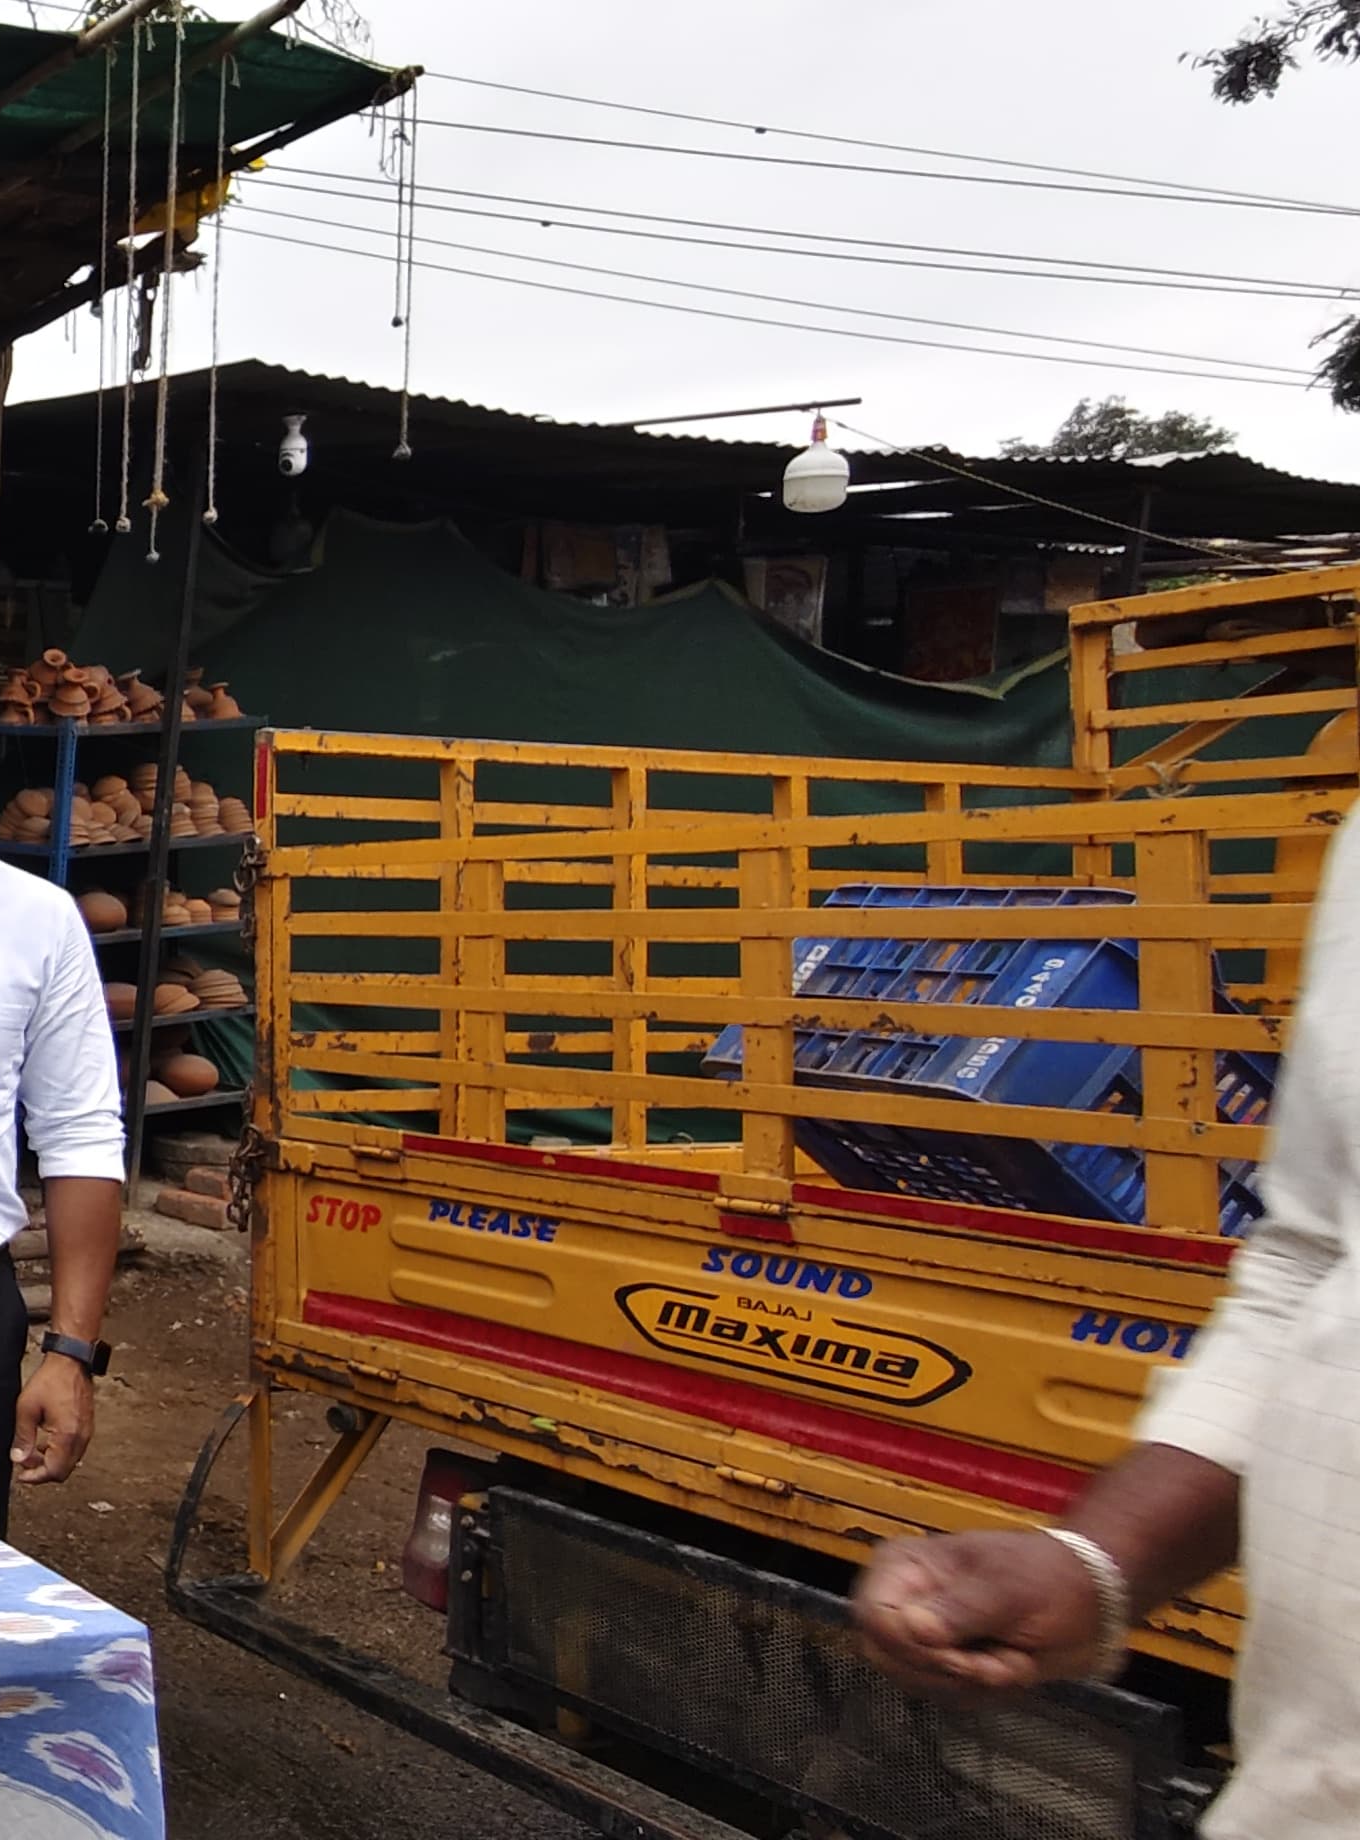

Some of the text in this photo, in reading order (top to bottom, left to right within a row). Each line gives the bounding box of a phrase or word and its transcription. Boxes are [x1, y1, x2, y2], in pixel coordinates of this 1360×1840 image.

[306, 1195, 382, 1232] STOP
[428, 1199, 562, 1244] PLEASE
[700, 1246, 874, 1300] SOUND
[656, 1299, 922, 1382] maxima
[736, 1296, 813, 1322] BAJAJ
